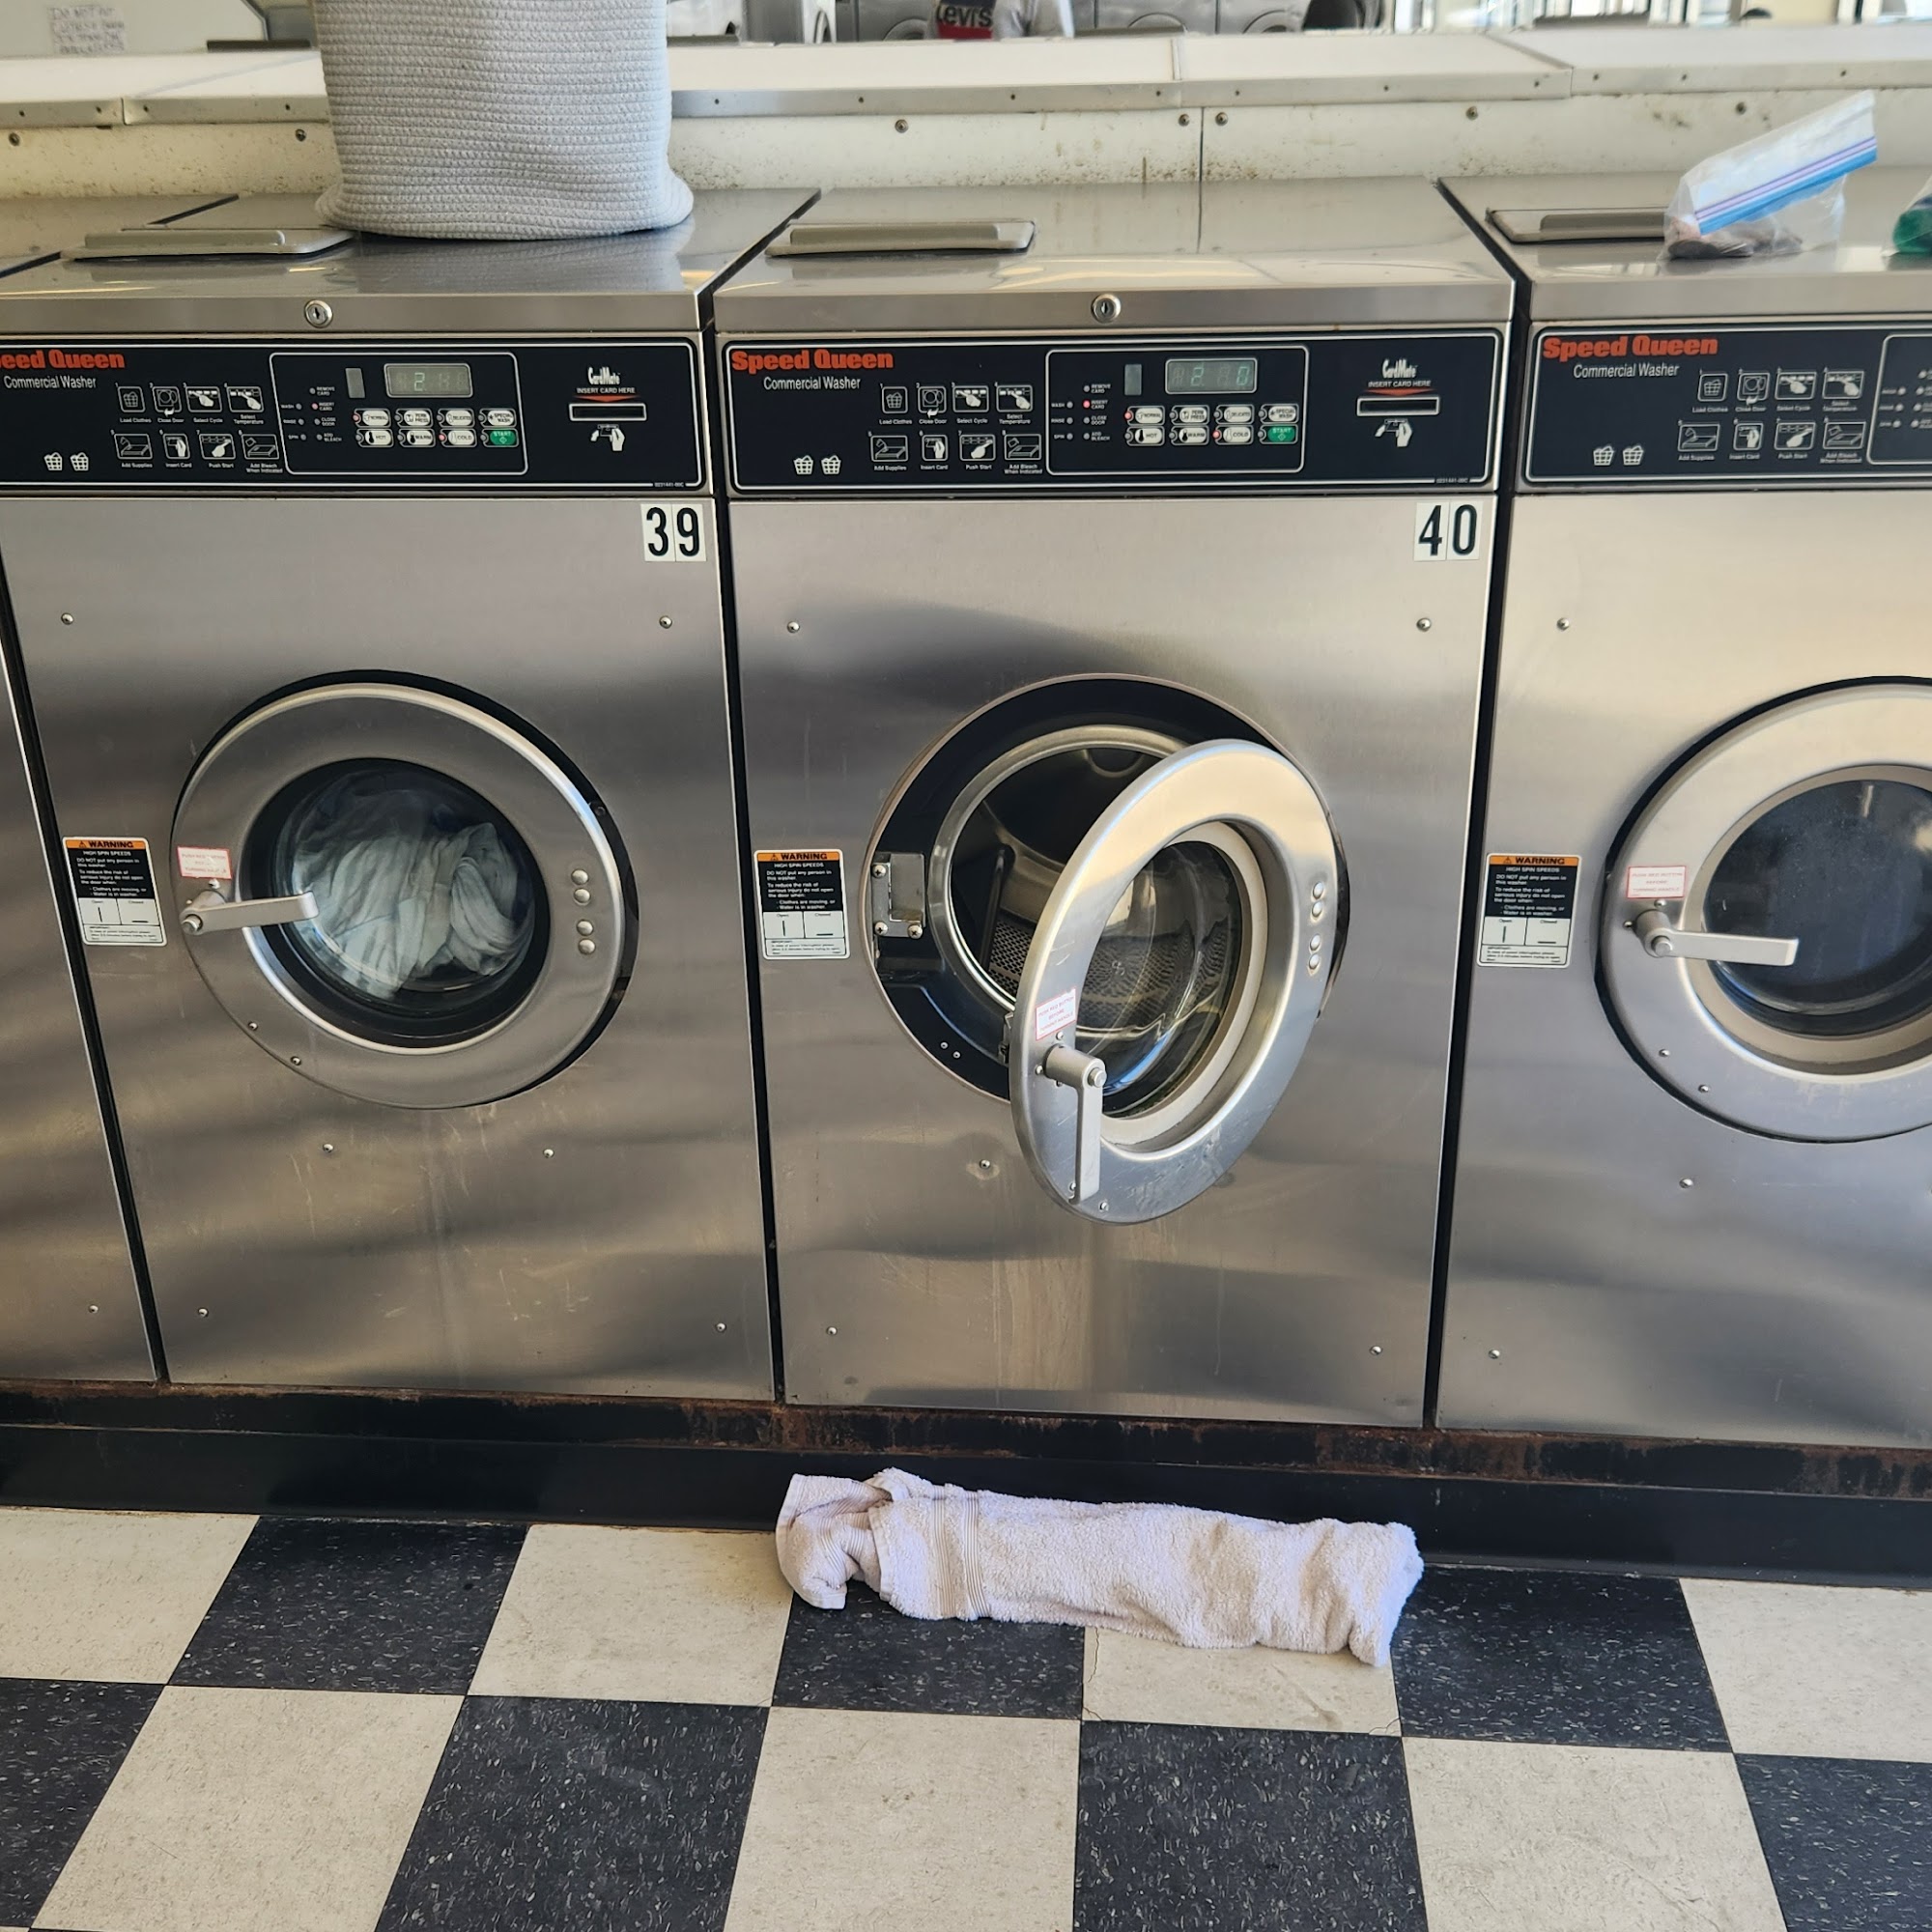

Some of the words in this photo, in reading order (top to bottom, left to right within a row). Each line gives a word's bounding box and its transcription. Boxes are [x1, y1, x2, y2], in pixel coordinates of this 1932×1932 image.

[1543, 336, 1628, 362] Speed
[1632, 335, 1719, 356] Queen
[0, 349, 45, 368] eed
[48, 349, 125, 368] Queen
[731, 350, 810, 375] Speed
[813, 349, 894, 369] Queen
[1191, 367, 1204, 385] 2
[1574, 363, 1635, 379] Commercial
[1639, 362, 1679, 377] Washer
[4, 375, 60, 388] Commercial
[60, 375, 97, 388] Washer
[763, 377, 821, 390] Commercial
[823, 376, 861, 389] Washer
[646, 507, 699, 556] 39
[1418, 504, 1477, 555] 40
